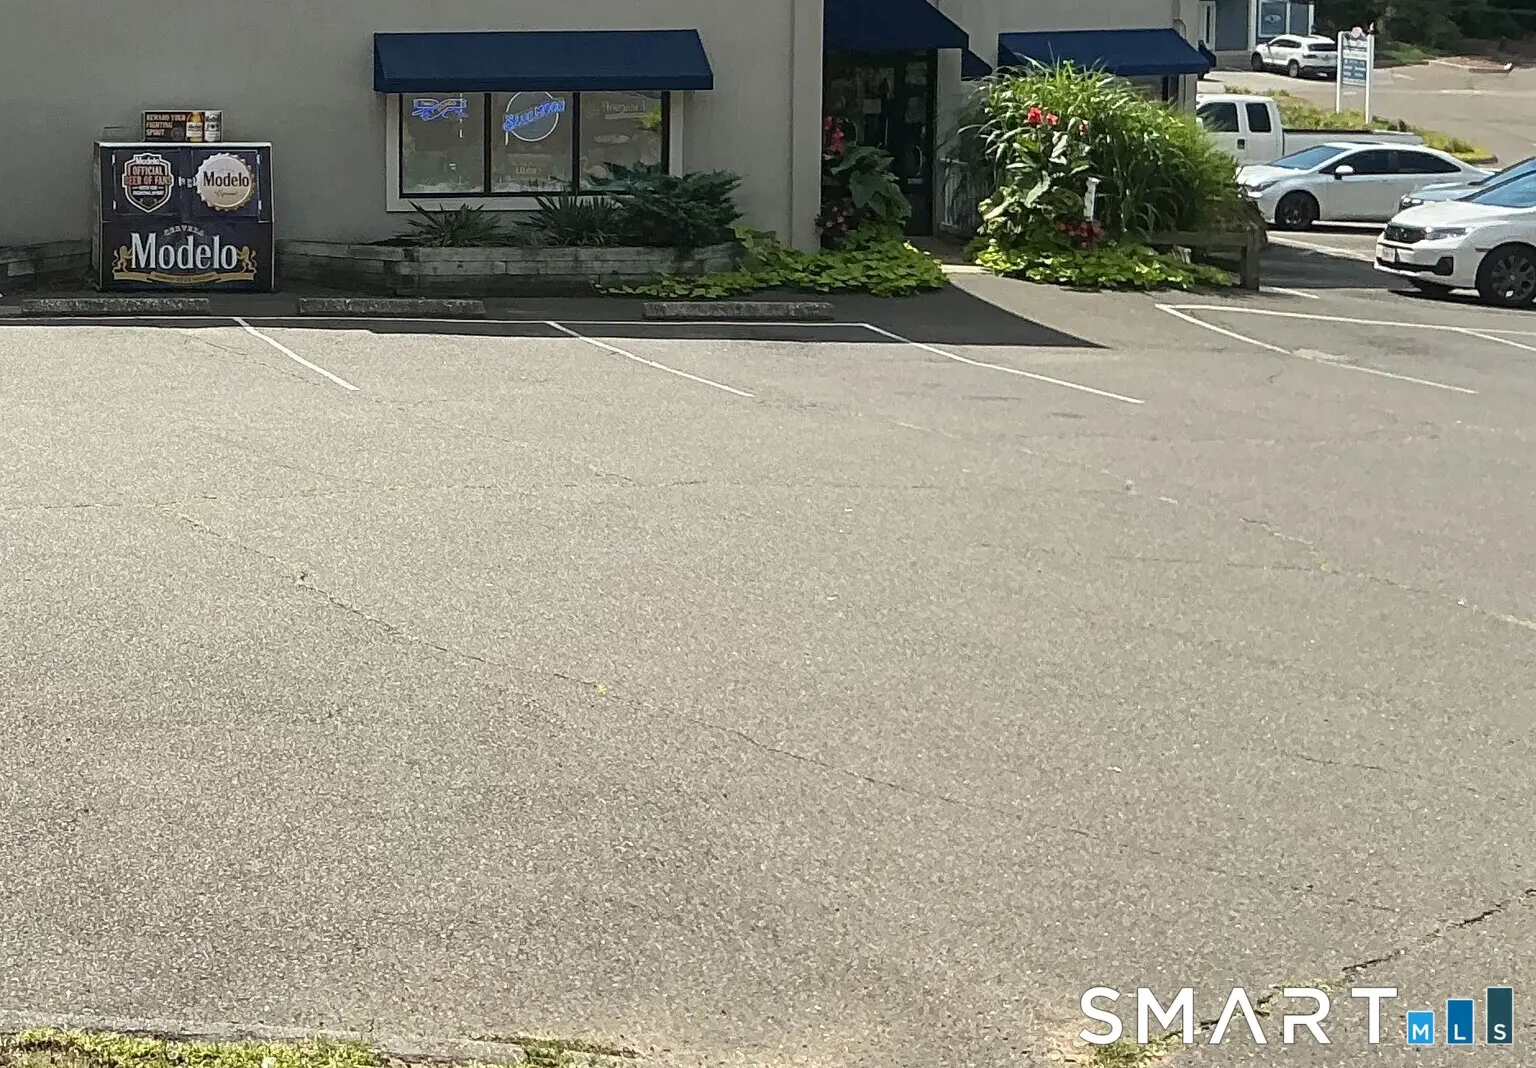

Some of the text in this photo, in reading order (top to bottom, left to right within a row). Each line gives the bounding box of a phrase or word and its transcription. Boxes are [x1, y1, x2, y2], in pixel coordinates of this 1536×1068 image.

[132, 166, 163, 175] OFFICIAL
[143, 176, 153, 185] OF
[154, 176, 172, 185] FANS
[203, 171, 250, 188] Modelo
[130, 232, 238, 270] Modelo
